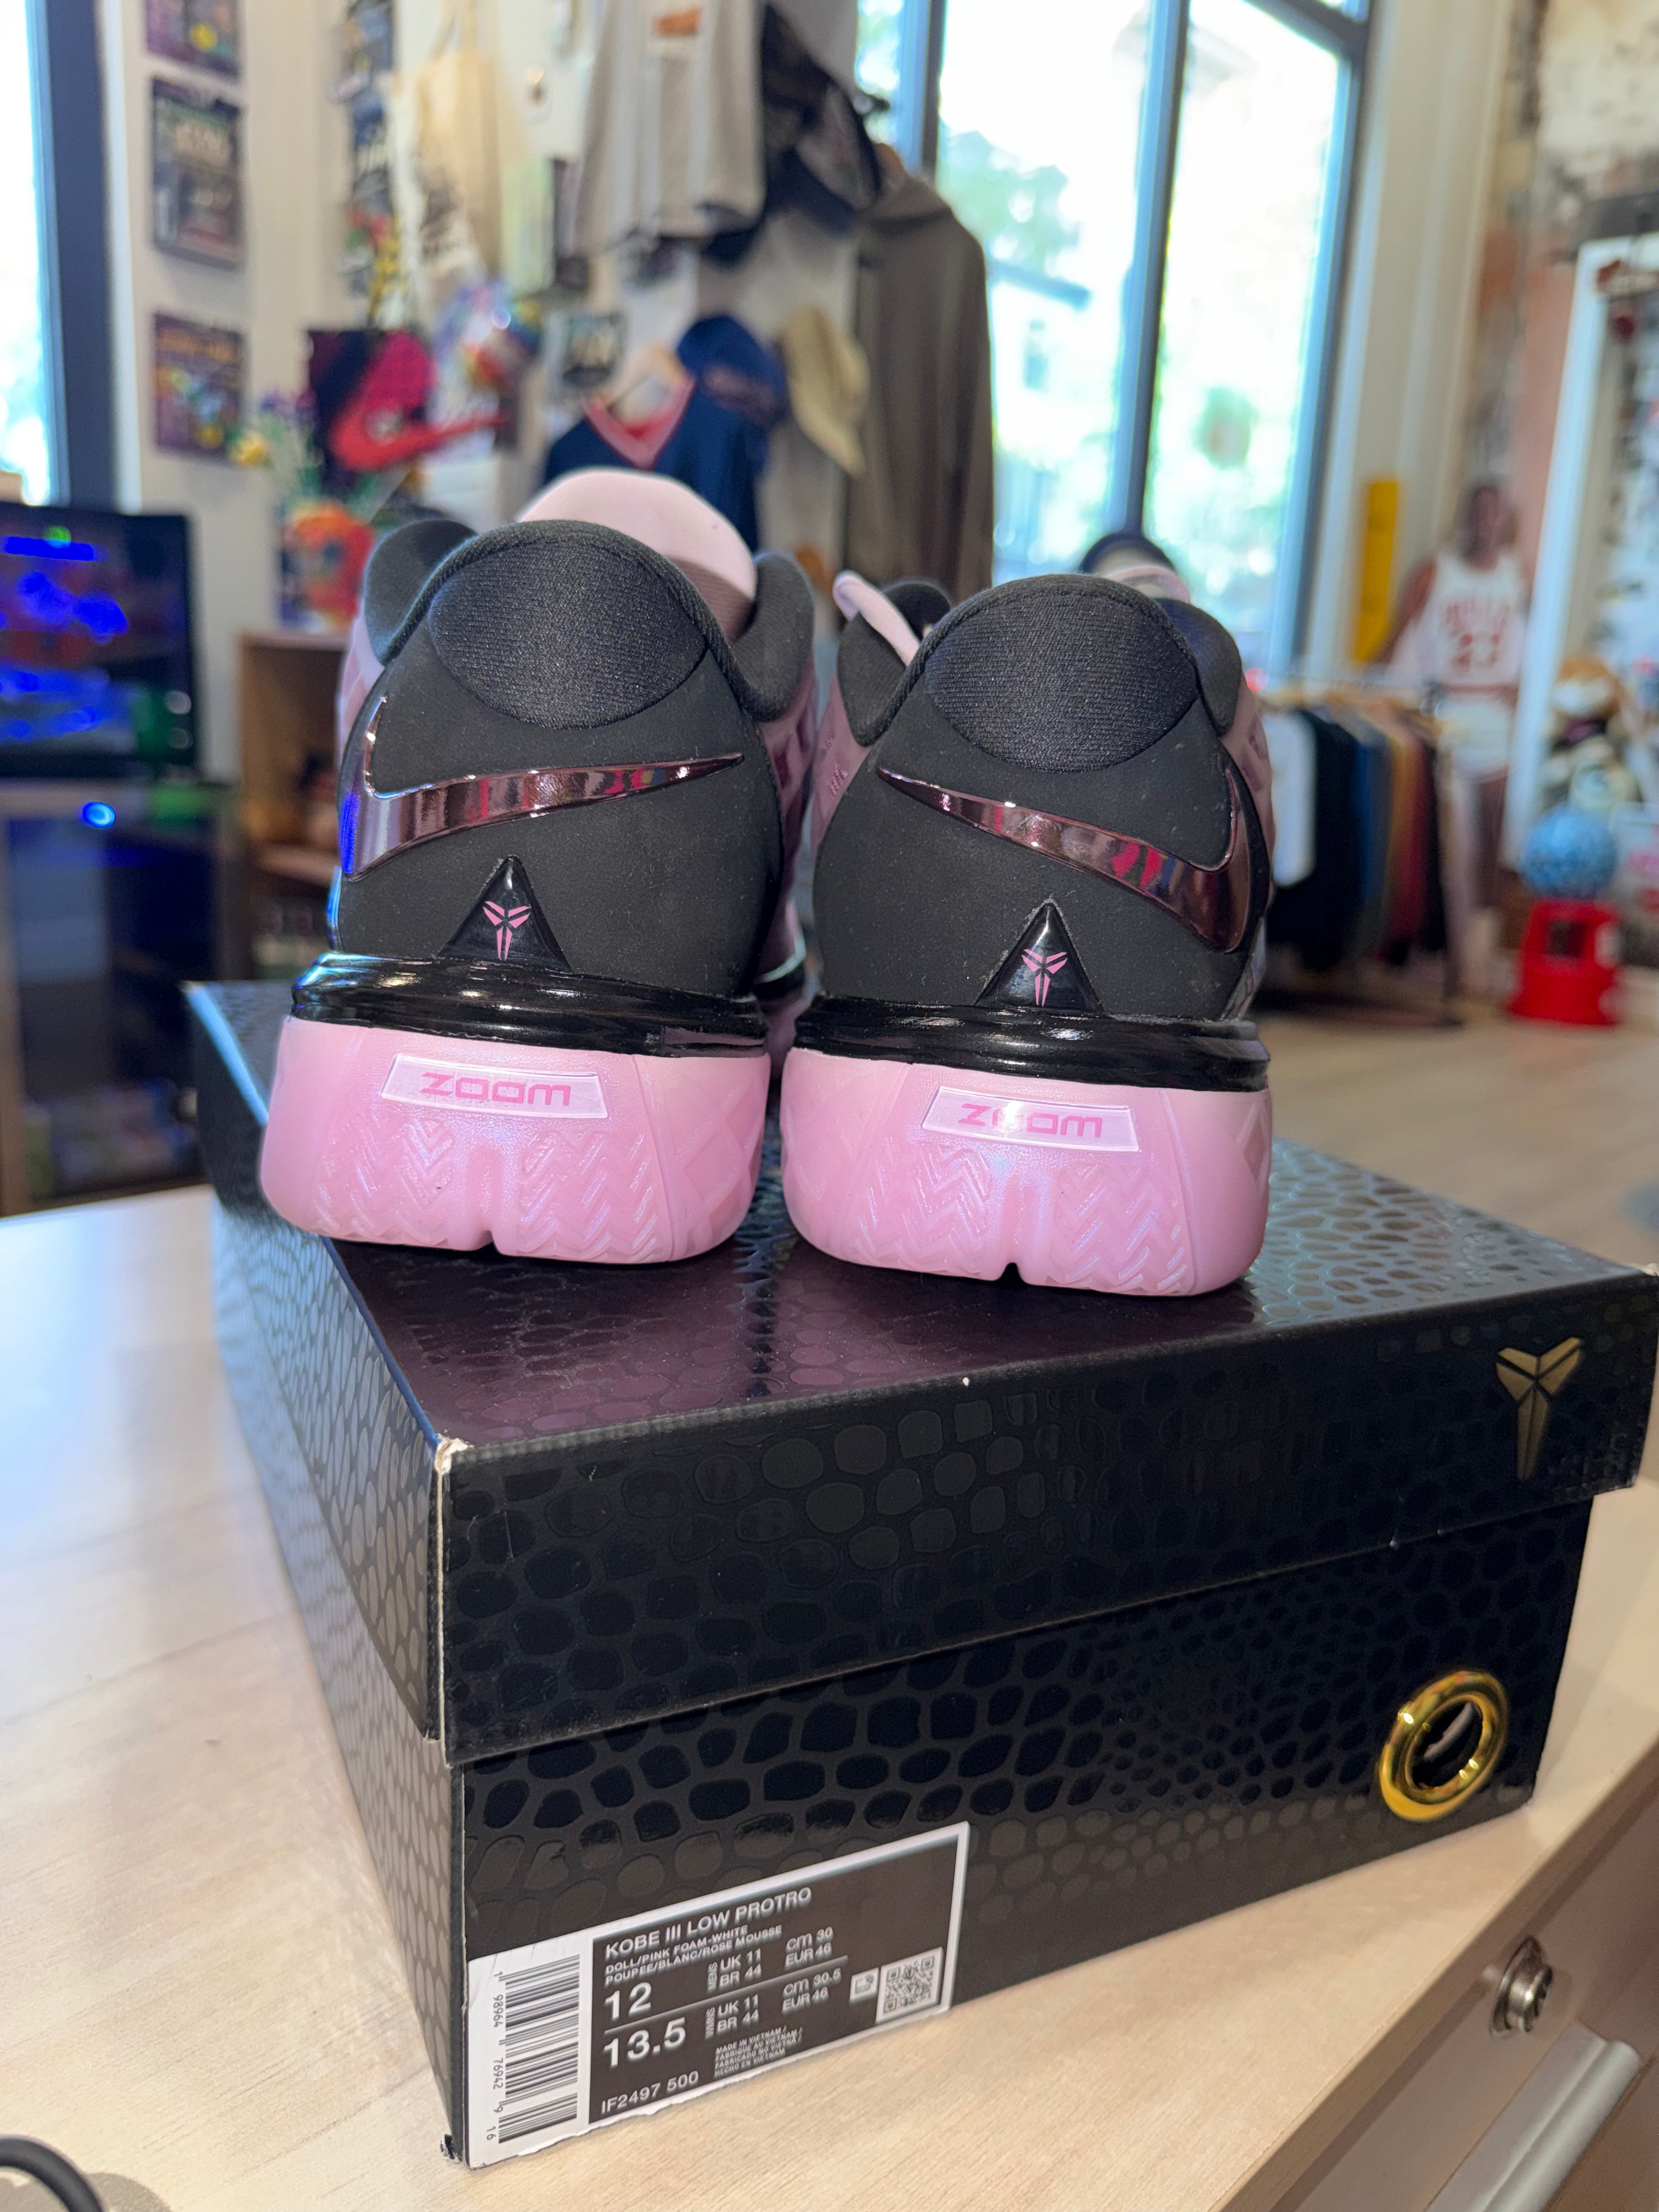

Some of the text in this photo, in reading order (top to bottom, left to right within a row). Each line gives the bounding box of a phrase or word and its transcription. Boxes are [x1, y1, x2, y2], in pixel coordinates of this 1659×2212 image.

[606, 1887, 812, 1959] KOBE III LOW PROTRO
[735, 1925, 782, 1949] MOUSSE
[605, 1925, 748, 1974] DOLL/PINK FOAM-WHITE
[786, 1927, 834, 1954] cm 30
[719, 1948, 761, 1974] UK 11
[785, 1942, 832, 1971] EUR 46
[719, 1964, 762, 1990] BR 44
[783, 1968, 842, 1999] cm 30.5
[493, 1994, 503, 2028] 98964
[605, 1982, 652, 2022] 12
[717, 1994, 759, 2019] UK 11
[782, 1987, 829, 2016] EUR 46
[716, 2009, 759, 2036] BR 44
[603, 2017, 686, 2069] 13.5
[715, 2041, 737, 2055] MADE
[739, 2038, 747, 2047] IN
[493, 2057, 503, 2090] 76942
[601, 2070, 699, 2114] IF2497 500
